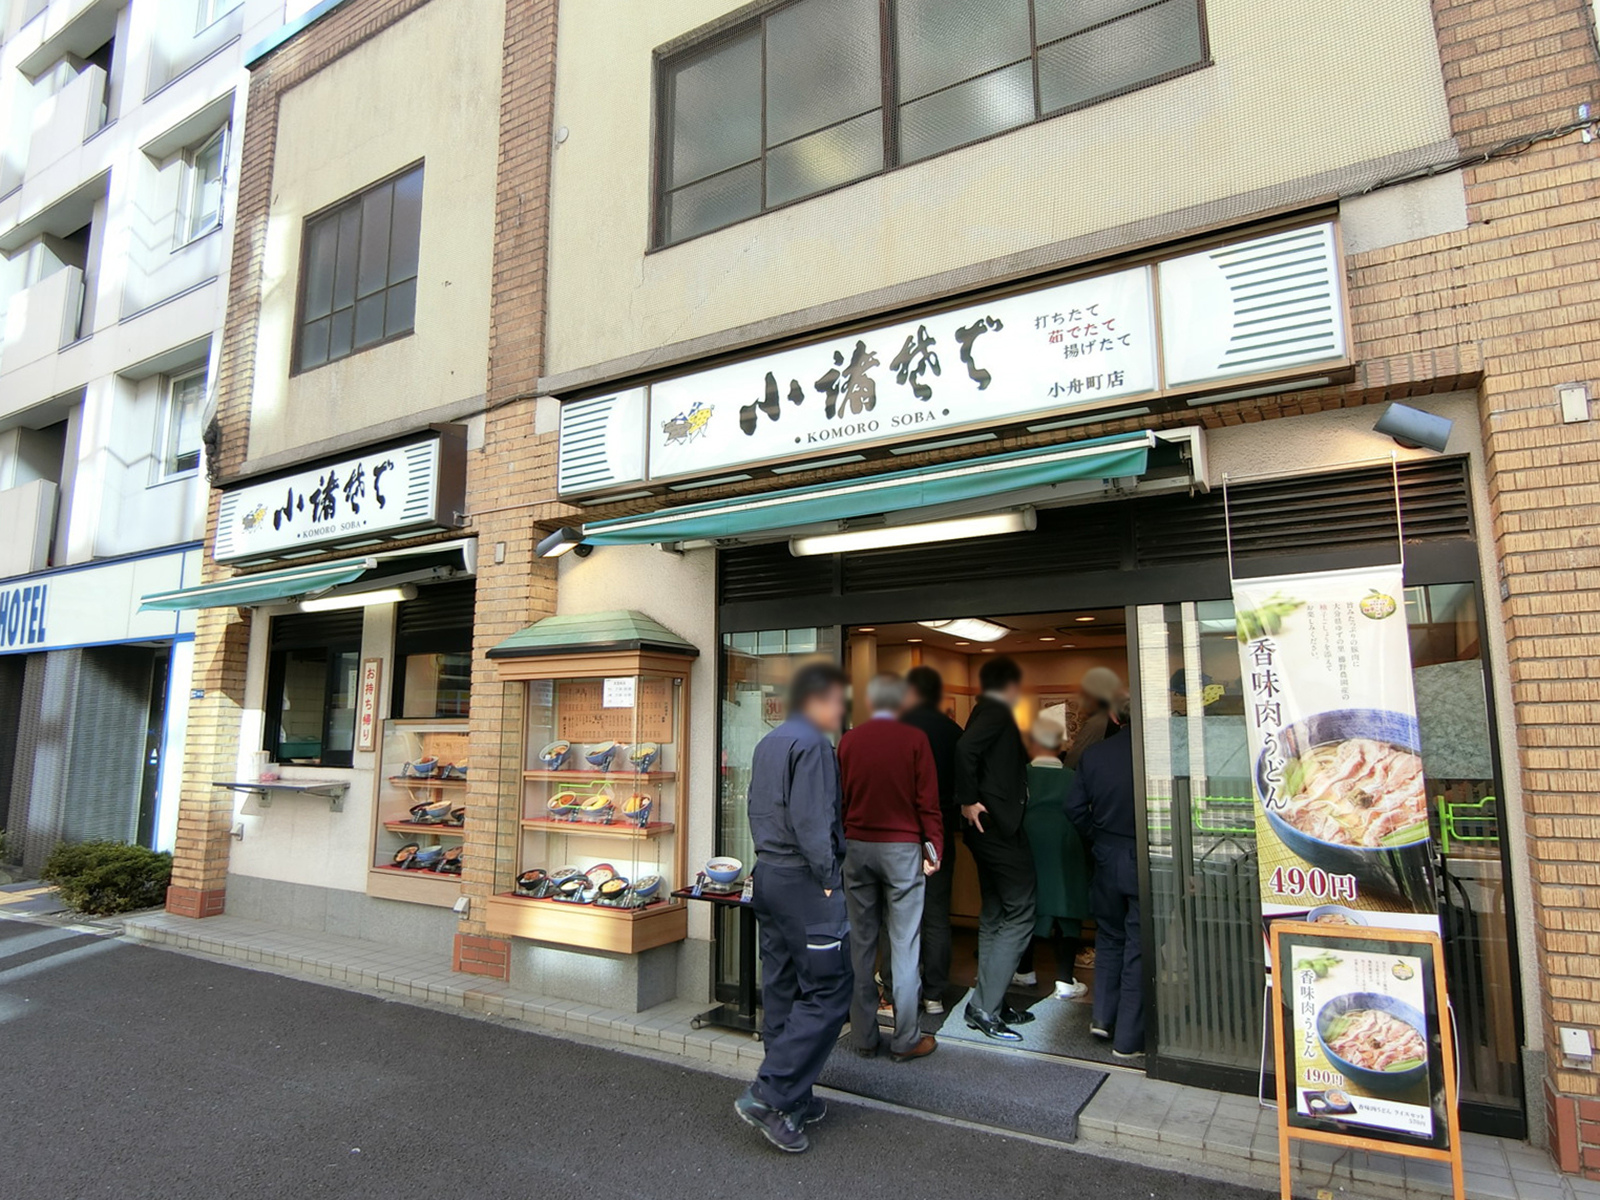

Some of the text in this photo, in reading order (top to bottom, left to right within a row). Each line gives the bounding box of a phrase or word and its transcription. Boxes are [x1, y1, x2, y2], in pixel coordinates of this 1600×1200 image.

[1034, 303, 1099, 330] 打ちたて
[1048, 318, 1116, 345] 茹でたて
[1063, 333, 1131, 359] 揚げたて
[1047, 370, 1125, 398] 小舟町店
[807, 409, 937, 444] KOMORO SOBA
[302, 520, 361, 539] KOMORO SOBA
[0, 584, 48, 647] HOTEL
[362, 667, 376, 742] お持ち帰り
[1249, 637, 1288, 812] 香味肉うどん
[1269, 865, 1358, 901] 490円
[1300, 969, 1316, 1058] 香味肉うどん
[1304, 1067, 1343, 1087] 490円
